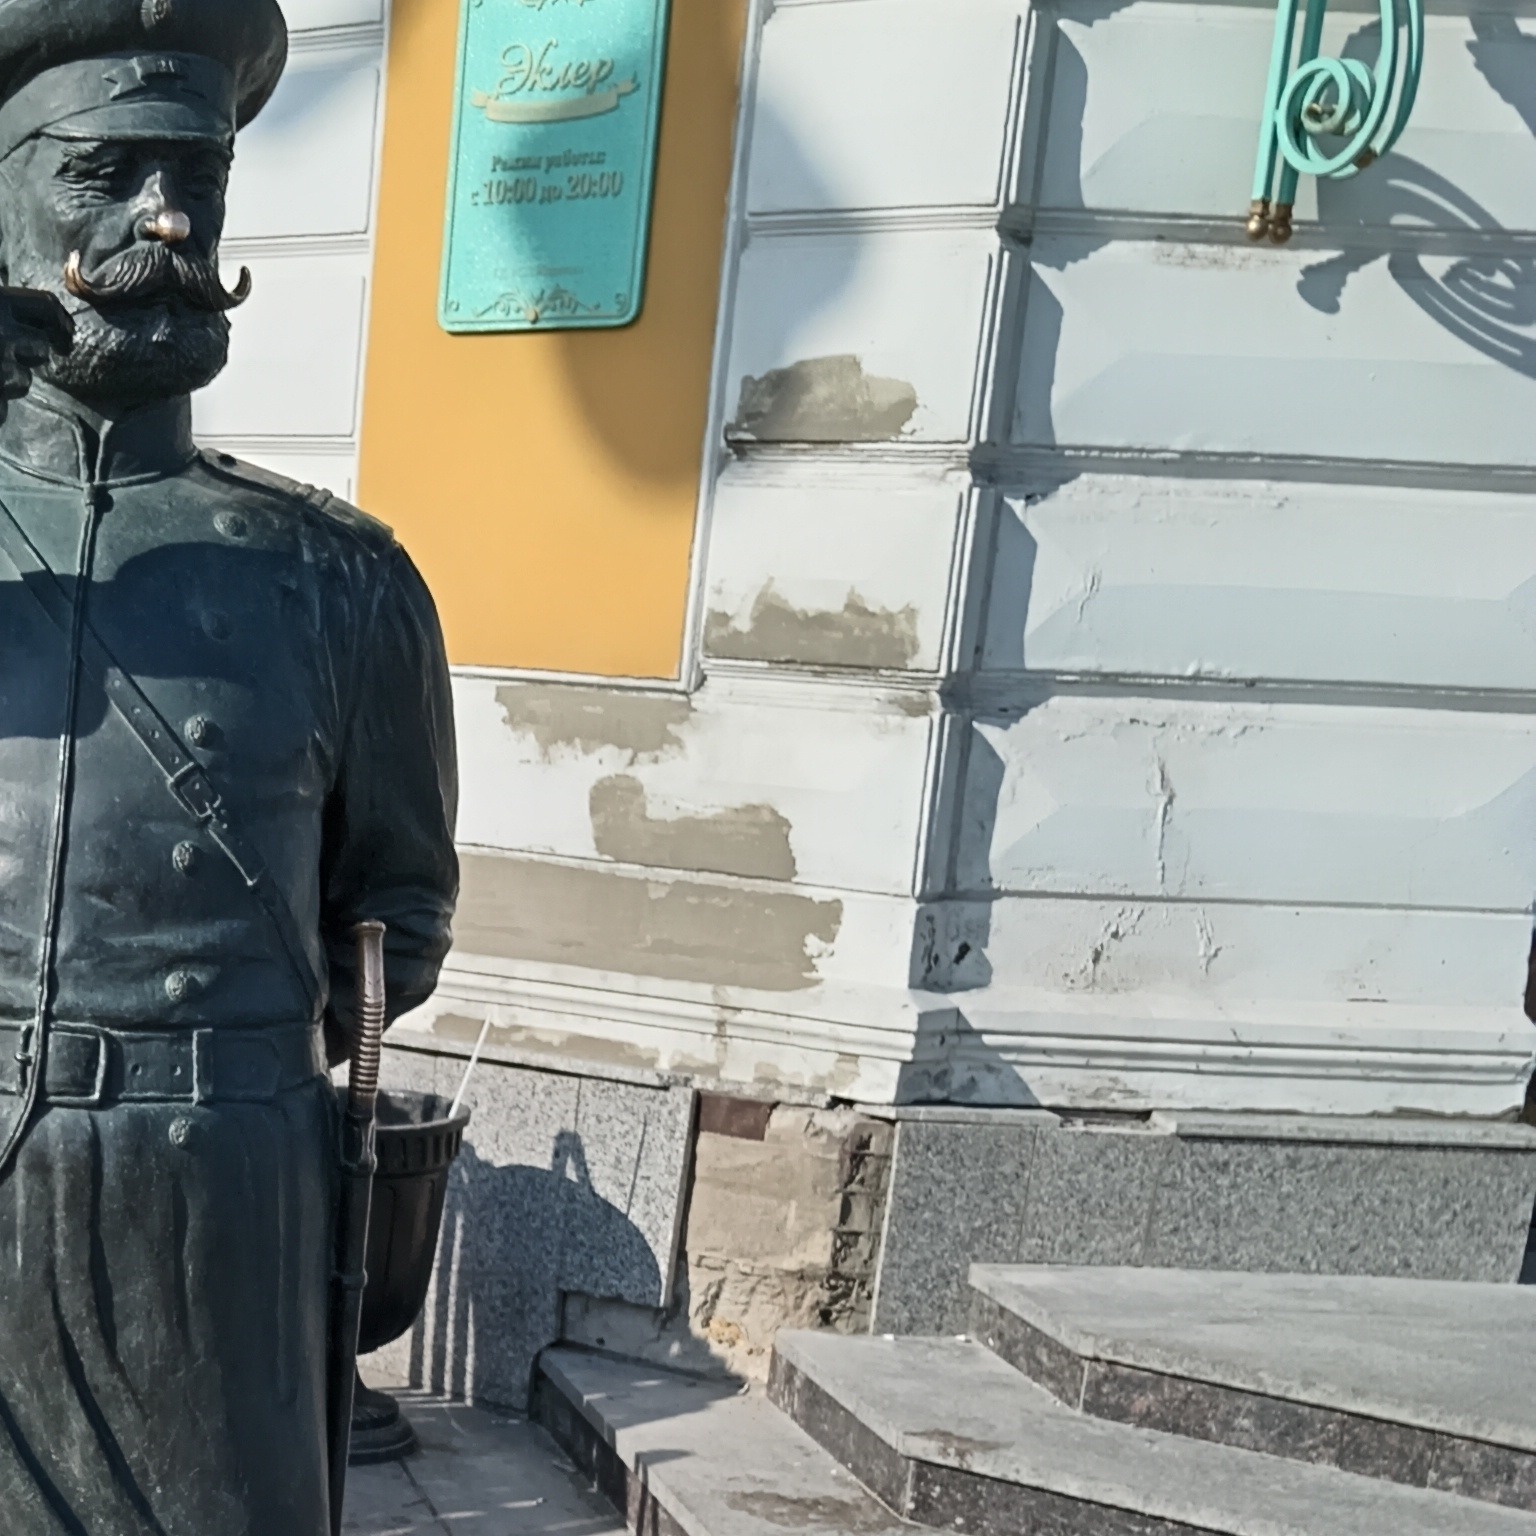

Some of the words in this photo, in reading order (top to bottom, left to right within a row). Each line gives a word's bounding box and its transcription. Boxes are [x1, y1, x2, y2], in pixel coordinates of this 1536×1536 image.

[497, 38, 614, 99] Эклер
[483, 176, 537, 206] 10:00
[538, 185, 562, 205] до
[565, 171, 624, 201] 20:00
